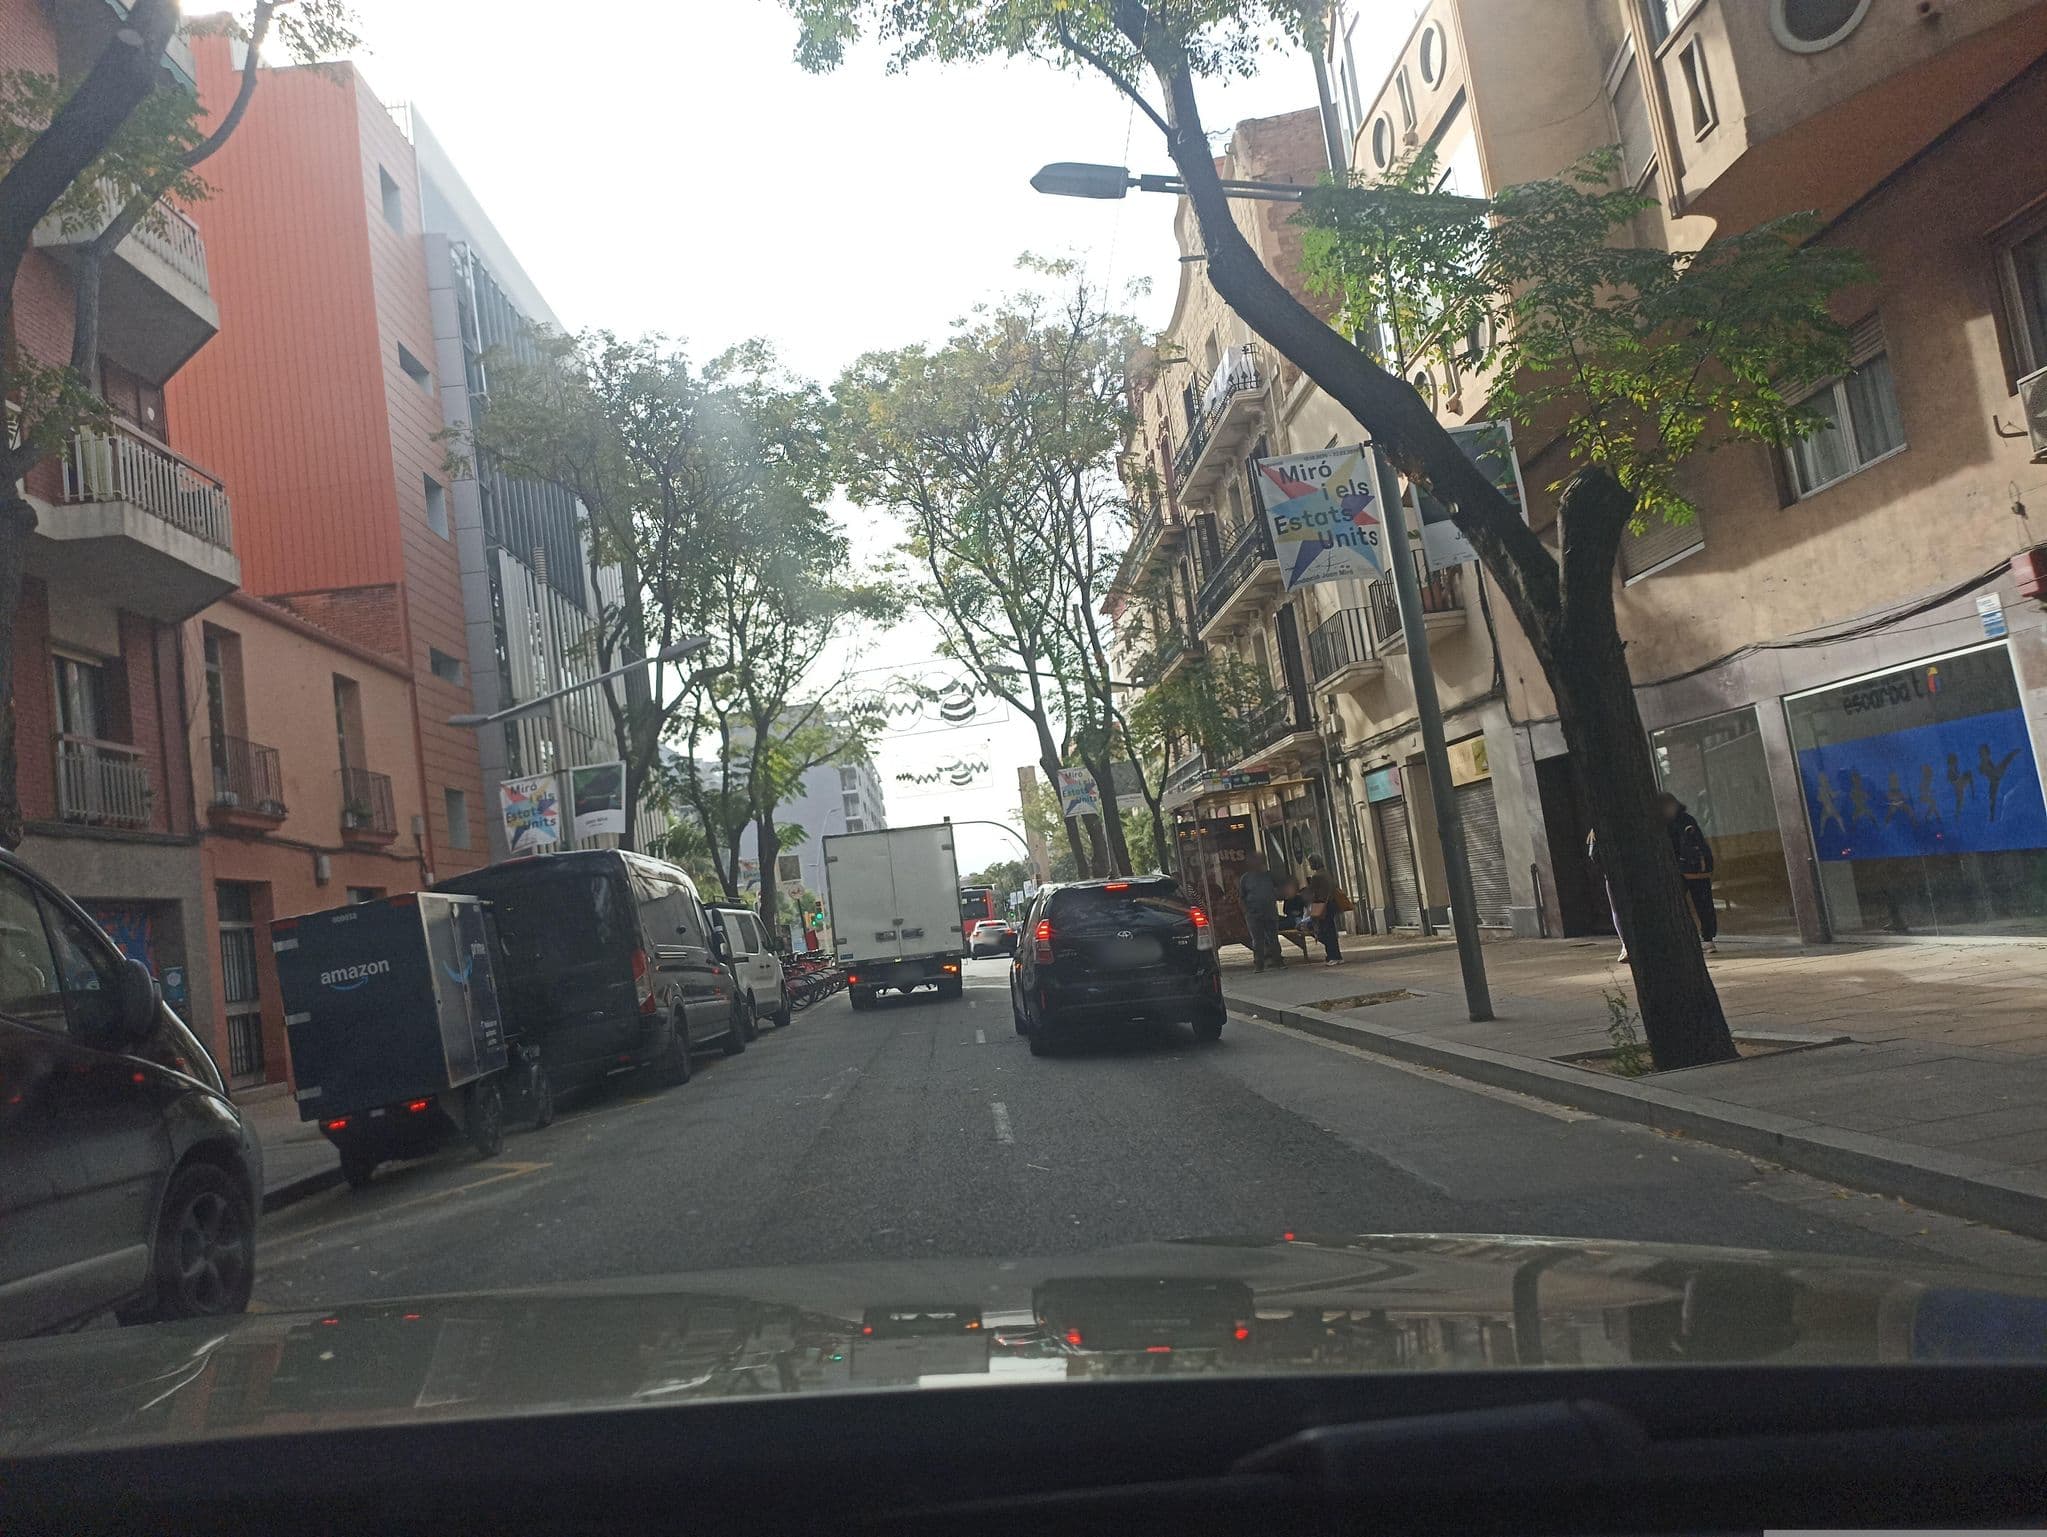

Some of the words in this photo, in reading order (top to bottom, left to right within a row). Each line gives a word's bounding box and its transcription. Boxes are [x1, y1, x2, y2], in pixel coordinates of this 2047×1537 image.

[1279, 460, 1332, 484] Miró
[1321, 483, 1329, 501] i
[1336, 479, 1370, 498] els
[1274, 506, 1353, 536] Estats
[1318, 527, 1378, 550] Units
[510, 782, 537, 796] Miró
[321, 959, 390, 985] amazon
